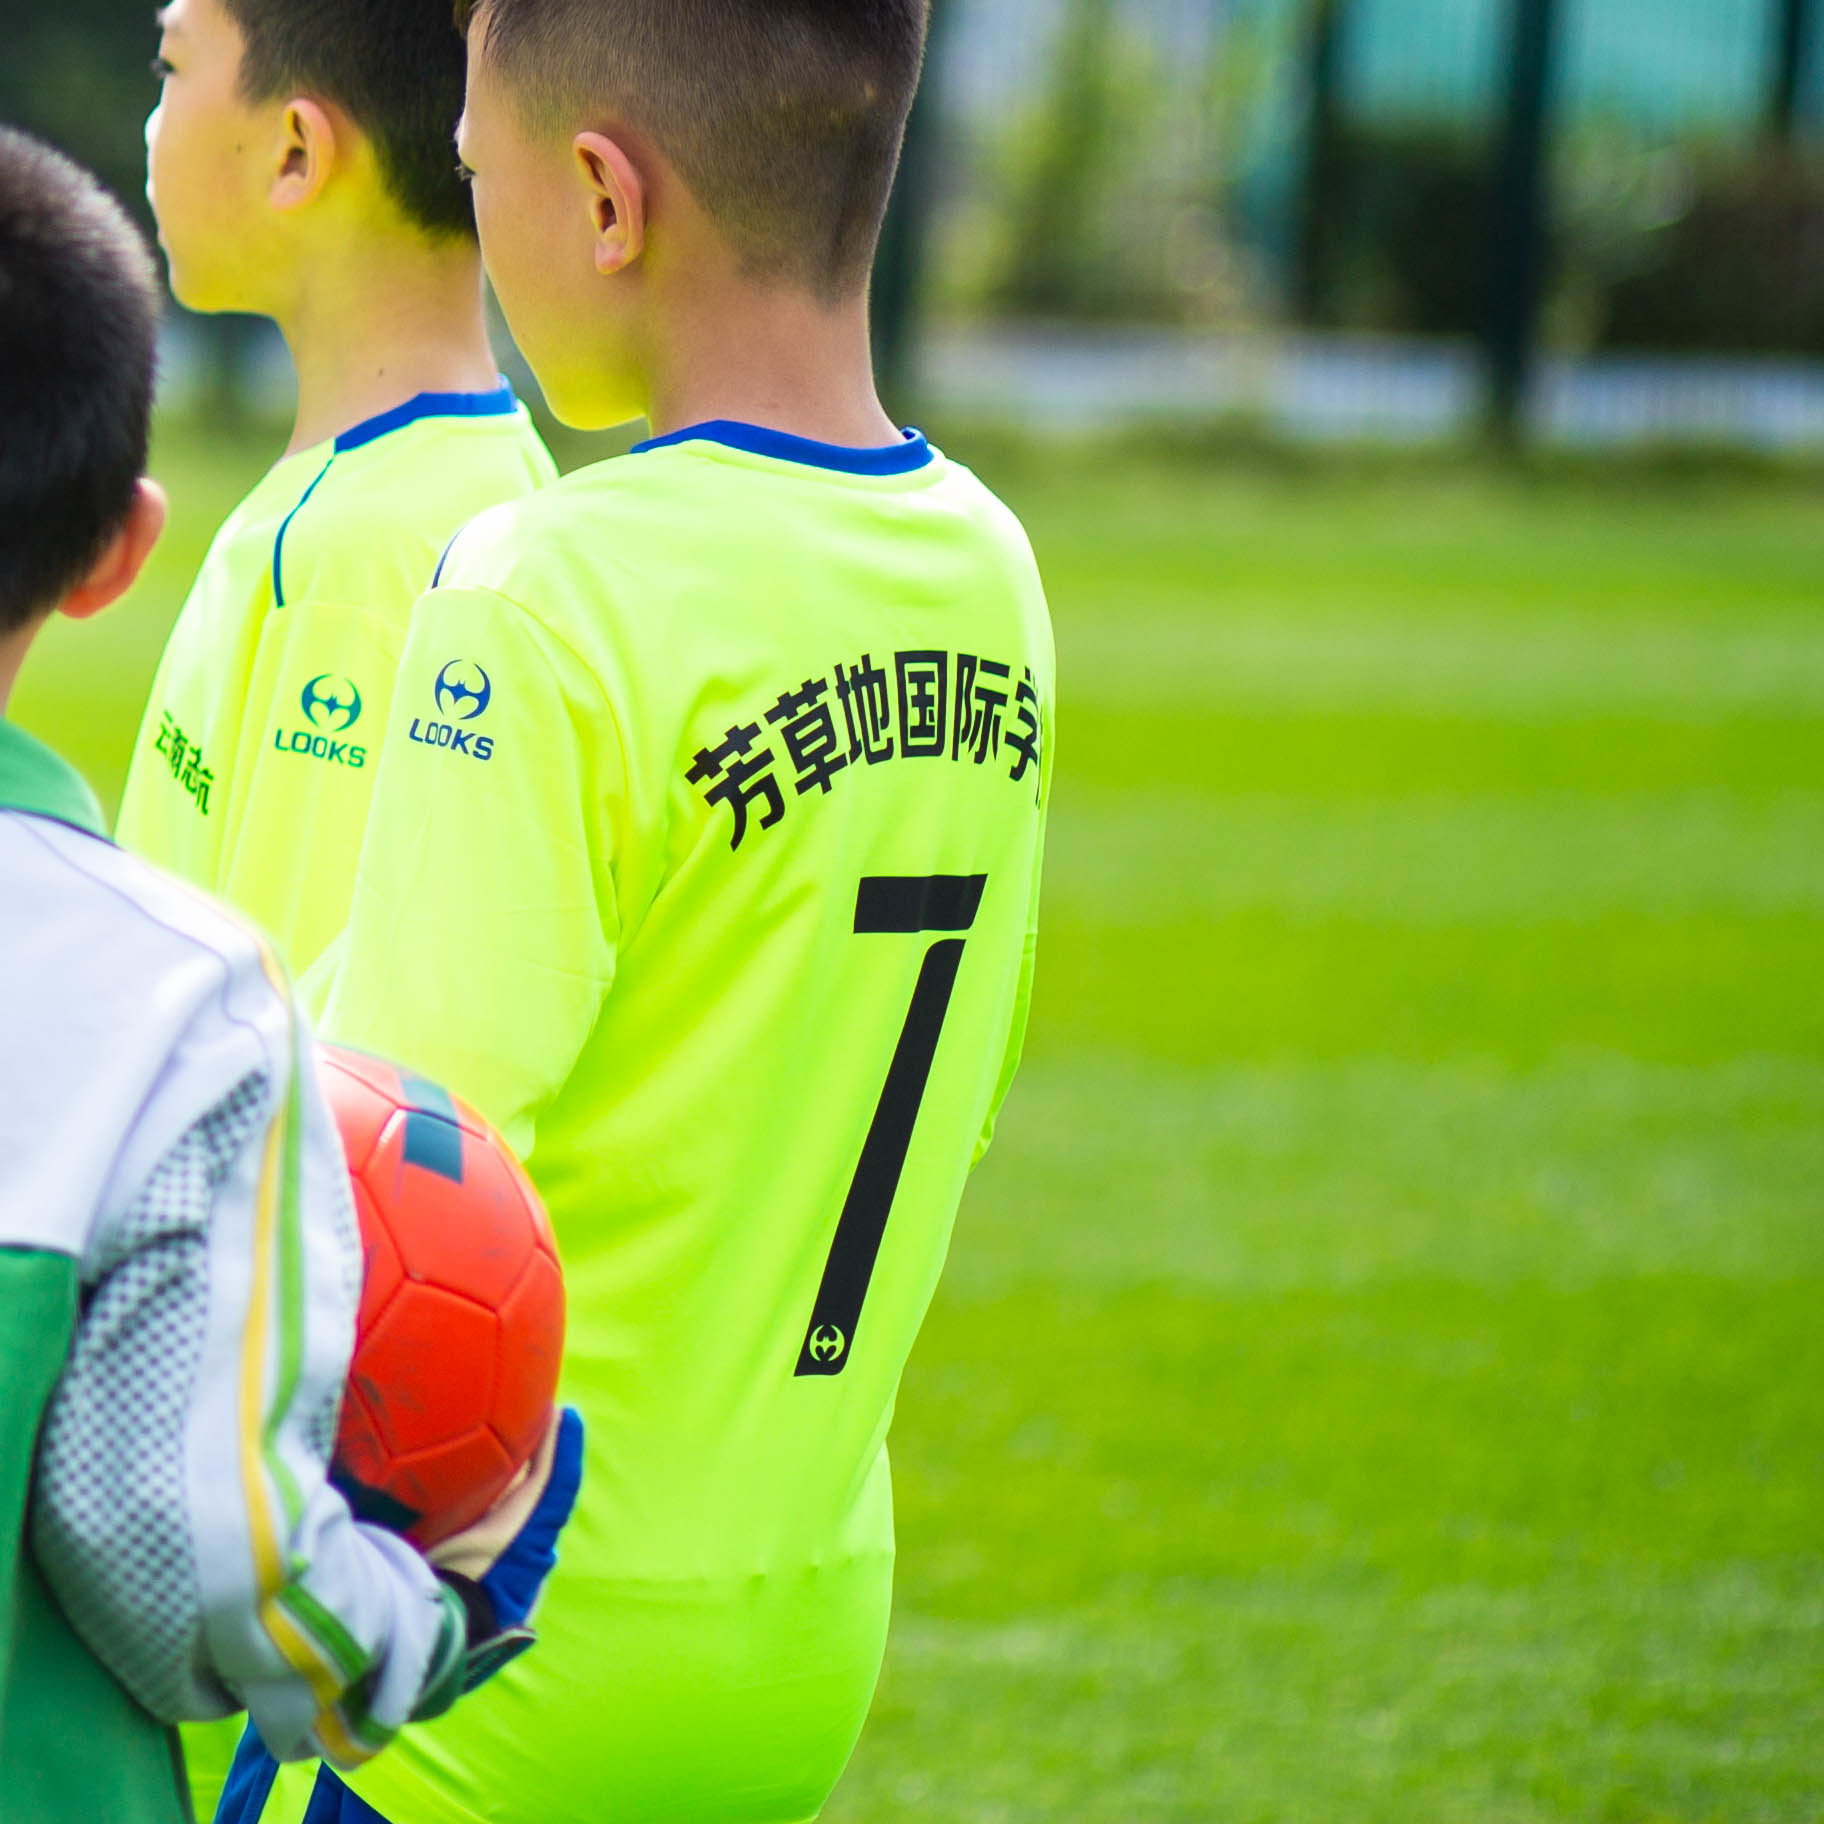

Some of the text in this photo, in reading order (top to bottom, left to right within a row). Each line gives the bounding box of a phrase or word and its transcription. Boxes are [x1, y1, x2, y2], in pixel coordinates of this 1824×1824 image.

[275, 728, 366, 769] LOOKS
[409, 718, 495, 761] LOOKS
[793, 873, 988, 1377] 7
